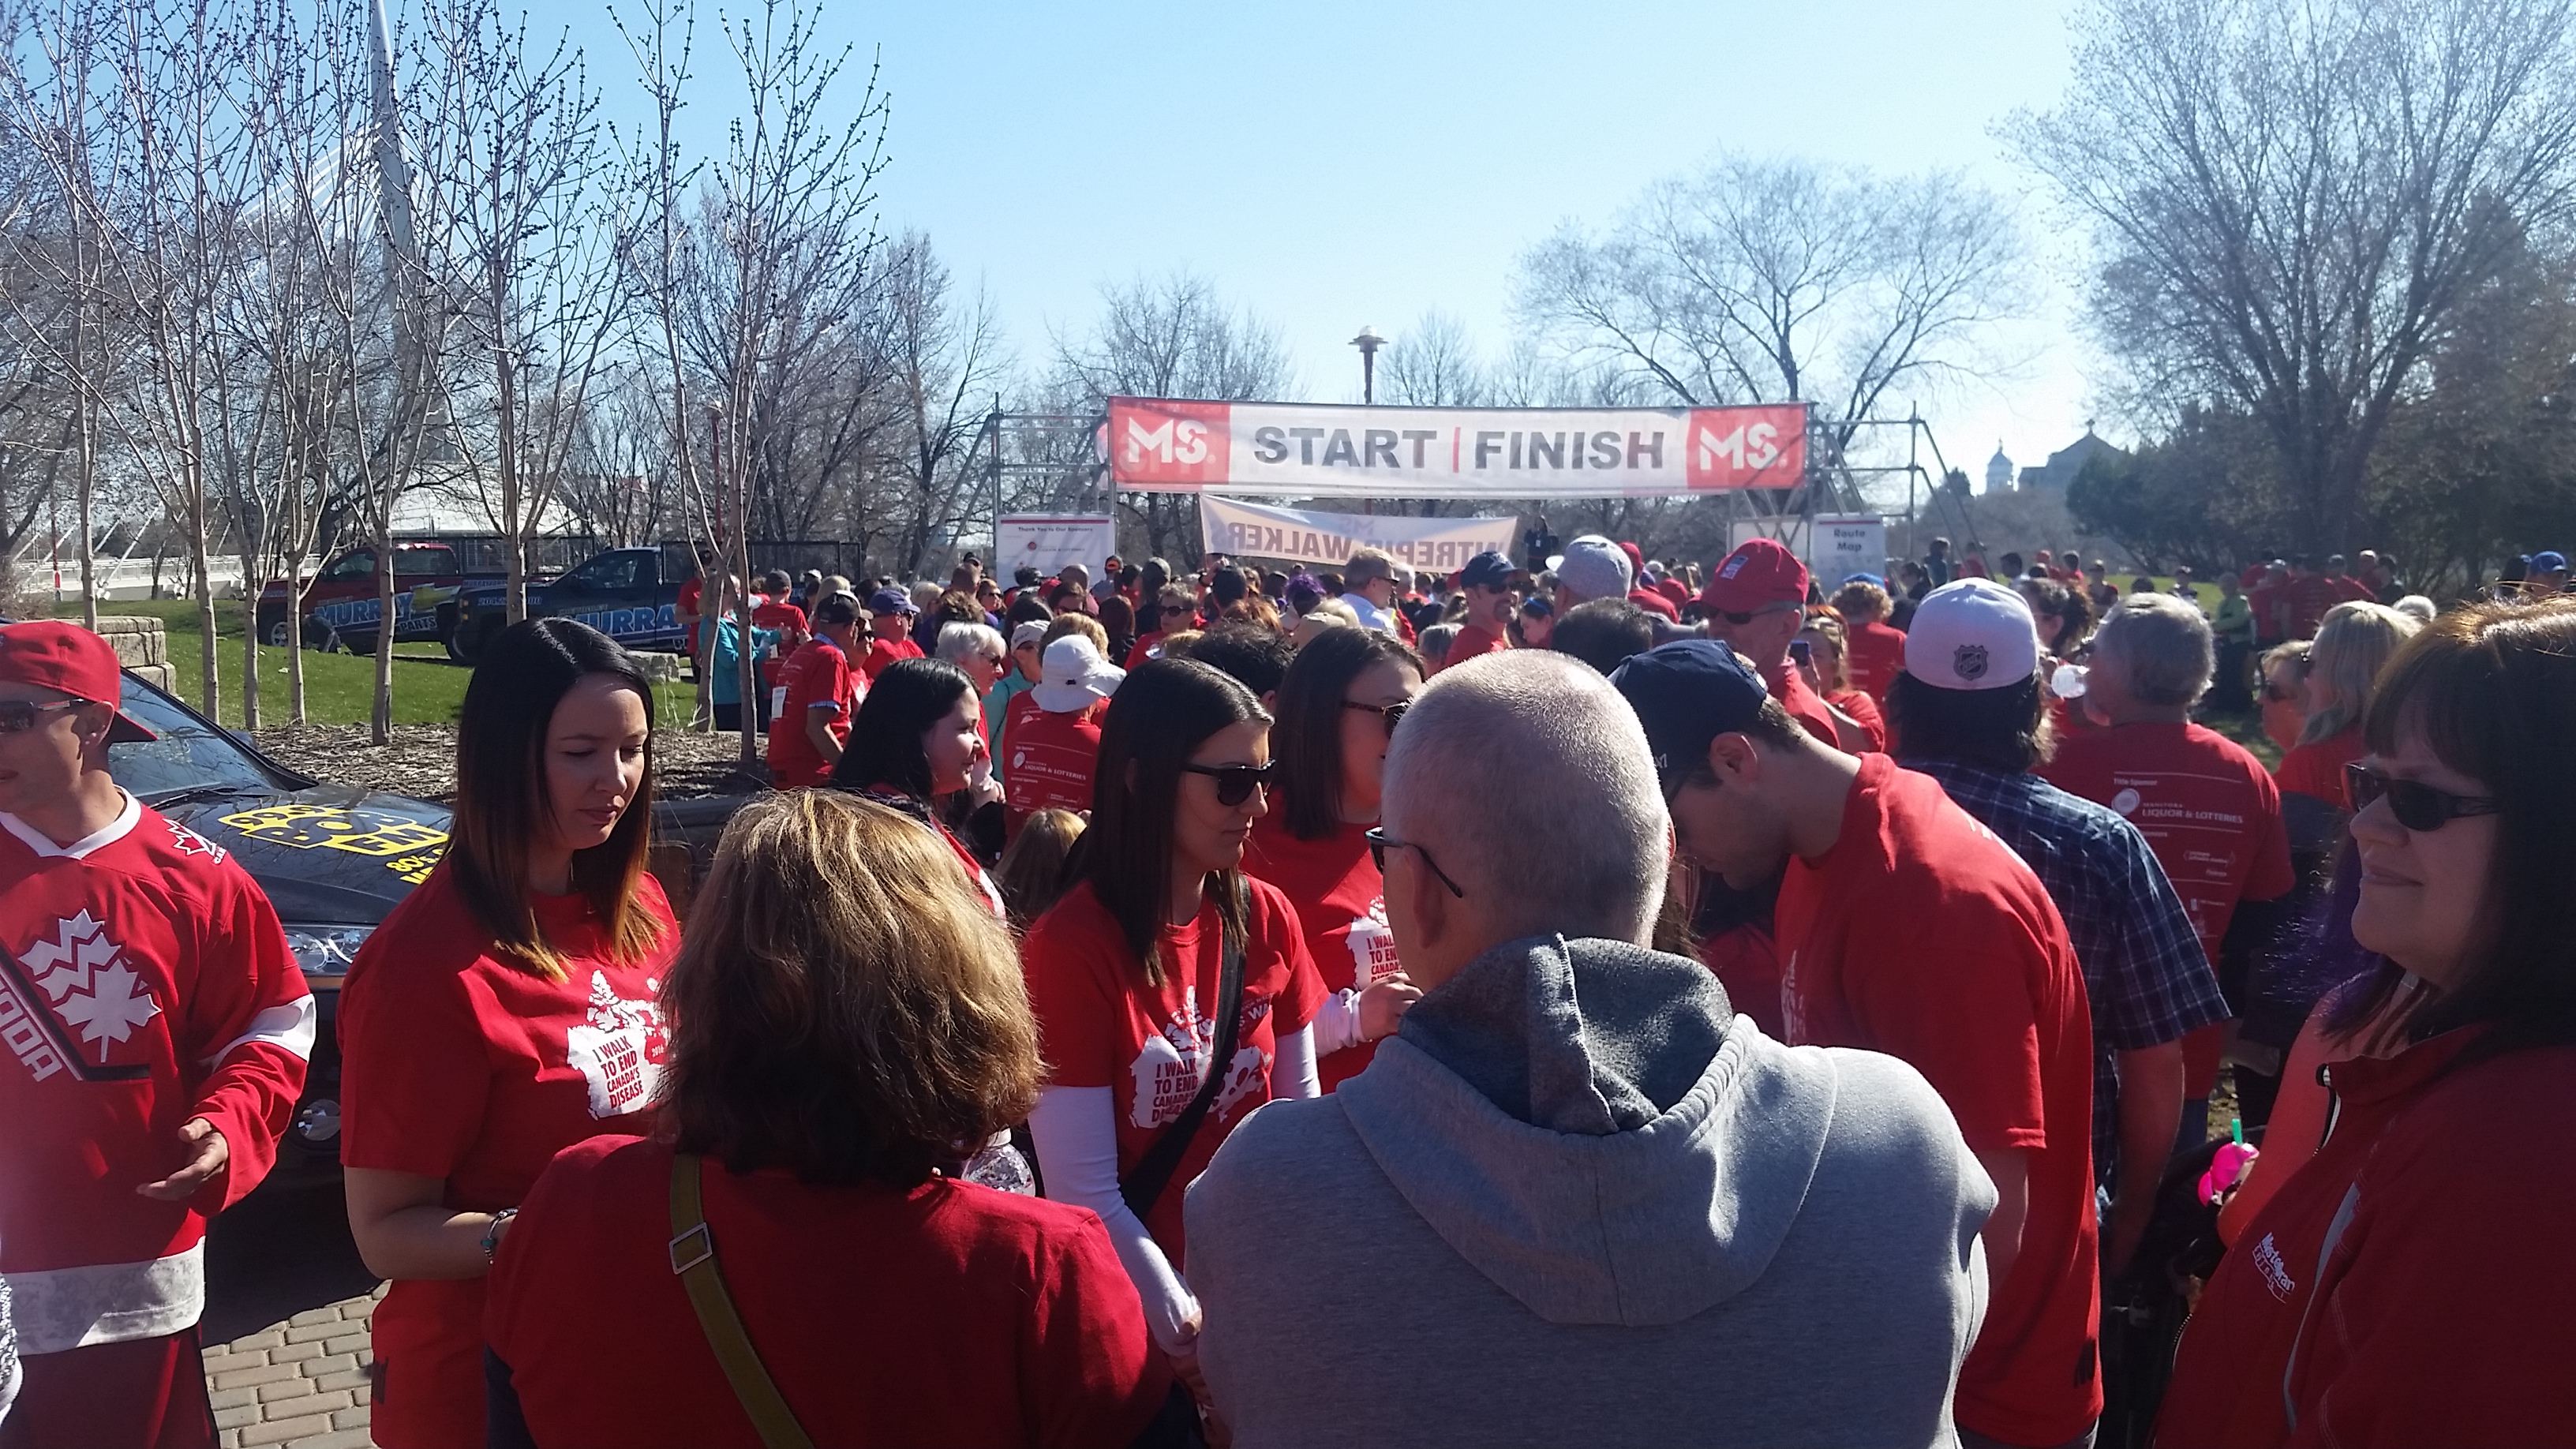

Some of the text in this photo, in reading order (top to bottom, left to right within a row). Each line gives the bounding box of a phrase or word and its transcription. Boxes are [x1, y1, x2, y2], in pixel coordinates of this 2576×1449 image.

[1253, 426, 1664, 470] START FINISH
[1834, 529, 1865, 538] Route
[1837, 542, 1862, 552] Map
[315, 593, 415, 628] MURRY
[575, 604, 683, 636] URRA
[400, 616, 437, 632] PARTS
[1054, 769, 1087, 781] LOTTERIES
[2142, 809, 2183, 818] LIQUOR
[2196, 811, 2243, 824] LOTTERIES
[1367, 934, 1395, 949] I WAL
[1369, 948, 1397, 964] TO EN
[1371, 962, 1400, 975] CANADA
[593, 1035, 633, 1062] I WALK
[601, 1050, 638, 1080] TO END
[1156, 1058, 1197, 1078] I WALK
[607, 1067, 640, 1093] CANADA'S
[1155, 1076, 1199, 1095] TO END
[609, 1080, 643, 1109] DISEASE
